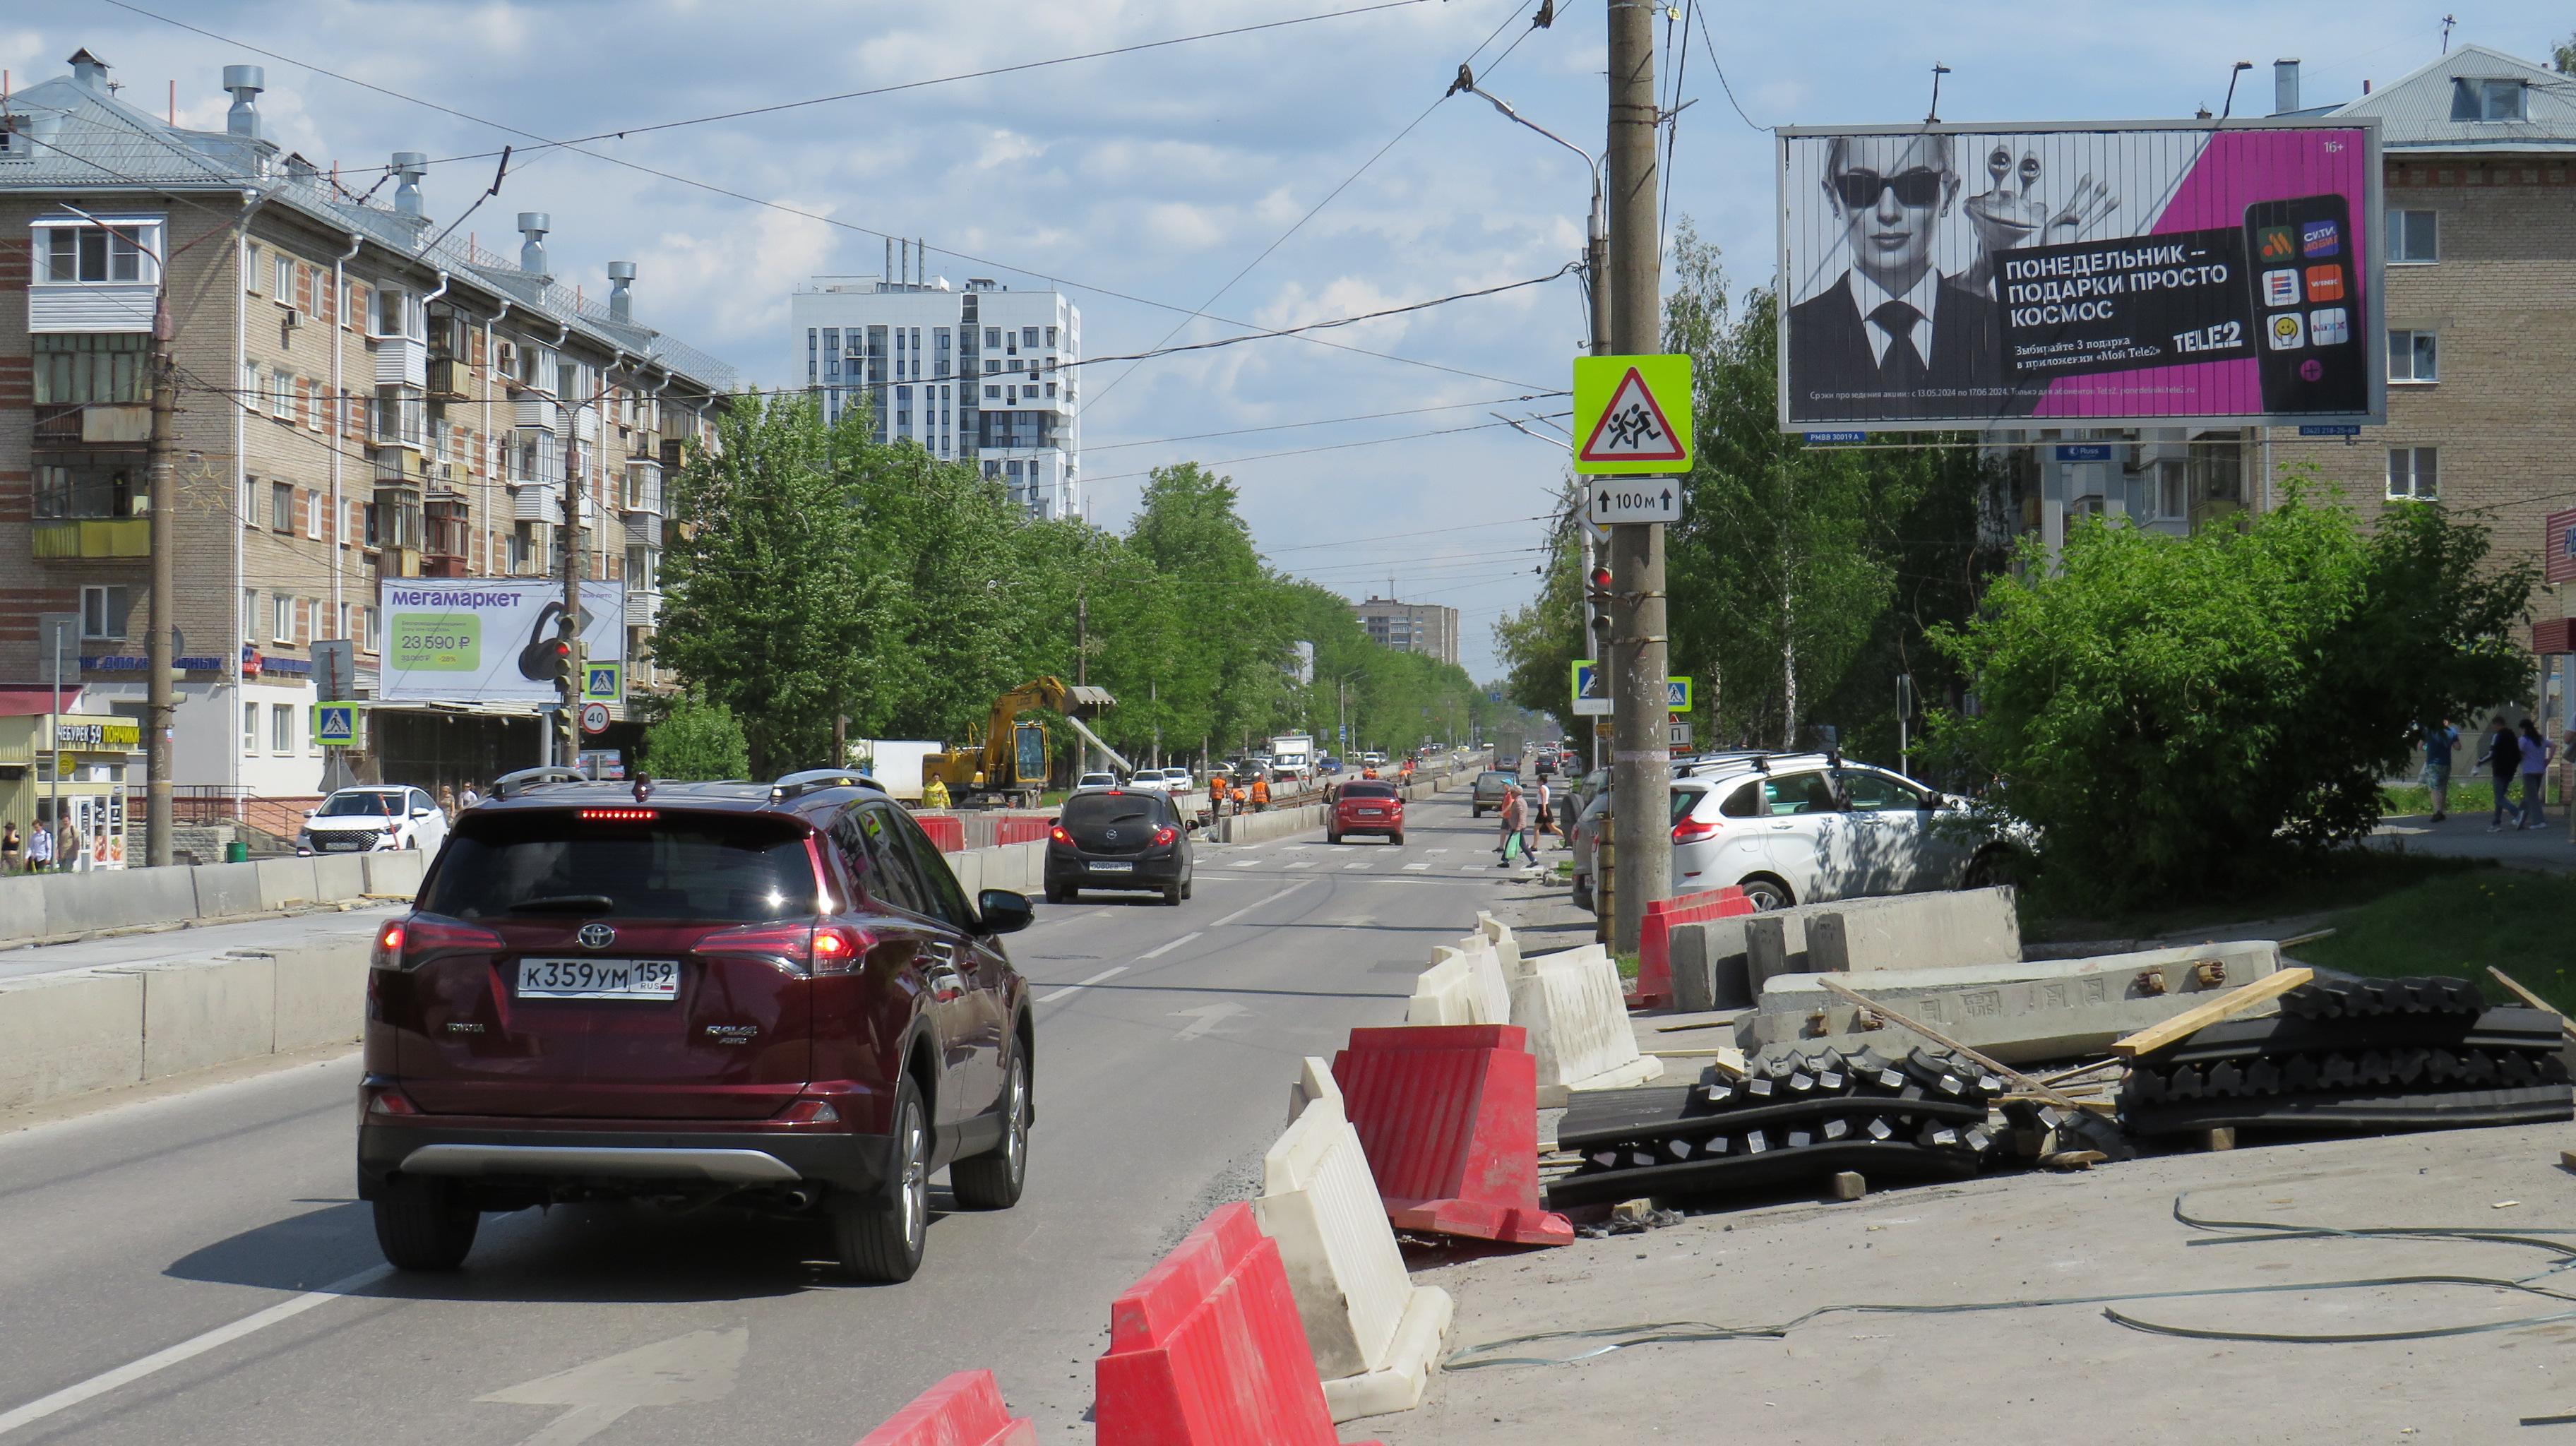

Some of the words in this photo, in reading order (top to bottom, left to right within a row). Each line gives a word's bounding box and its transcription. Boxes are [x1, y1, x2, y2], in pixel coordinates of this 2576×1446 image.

[2323, 141, 2344, 153] 16+
[2303, 226, 2334, 241] СИТИ
[2005, 244, 2186, 280] ПОНЕДЕЛЬНИК
[2008, 275, 2125, 304] ПОДАРКИ
[2129, 263, 2229, 292] ПРОСТО
[2010, 299, 2114, 328] КОСМОС
[2173, 320, 2243, 354] TELE2
[2015, 342, 2075, 356] Выбирайте
[2077, 339, 2083, 349] 3
[2086, 337, 2130, 349] подарка
[2025, 355, 2094, 370] приложении
[1809, 391, 1835, 401] Сроки
[1917, 388, 1956, 398] 13.05.2024
[392, 590, 522, 609] мегамаркет
[401, 635, 422, 649] 23
[424, 635, 455, 650] 590
[588, 712, 604, 724] 40
[90, 724, 102, 744] 59
[102, 726, 140, 743] ПОНЧИКИ
[527, 962, 628, 988] К359УМ
[634, 962, 672, 982] 159
[446, 1022, 485, 1032] TOYOTA
[705, 1025, 758, 1036] RAV4
